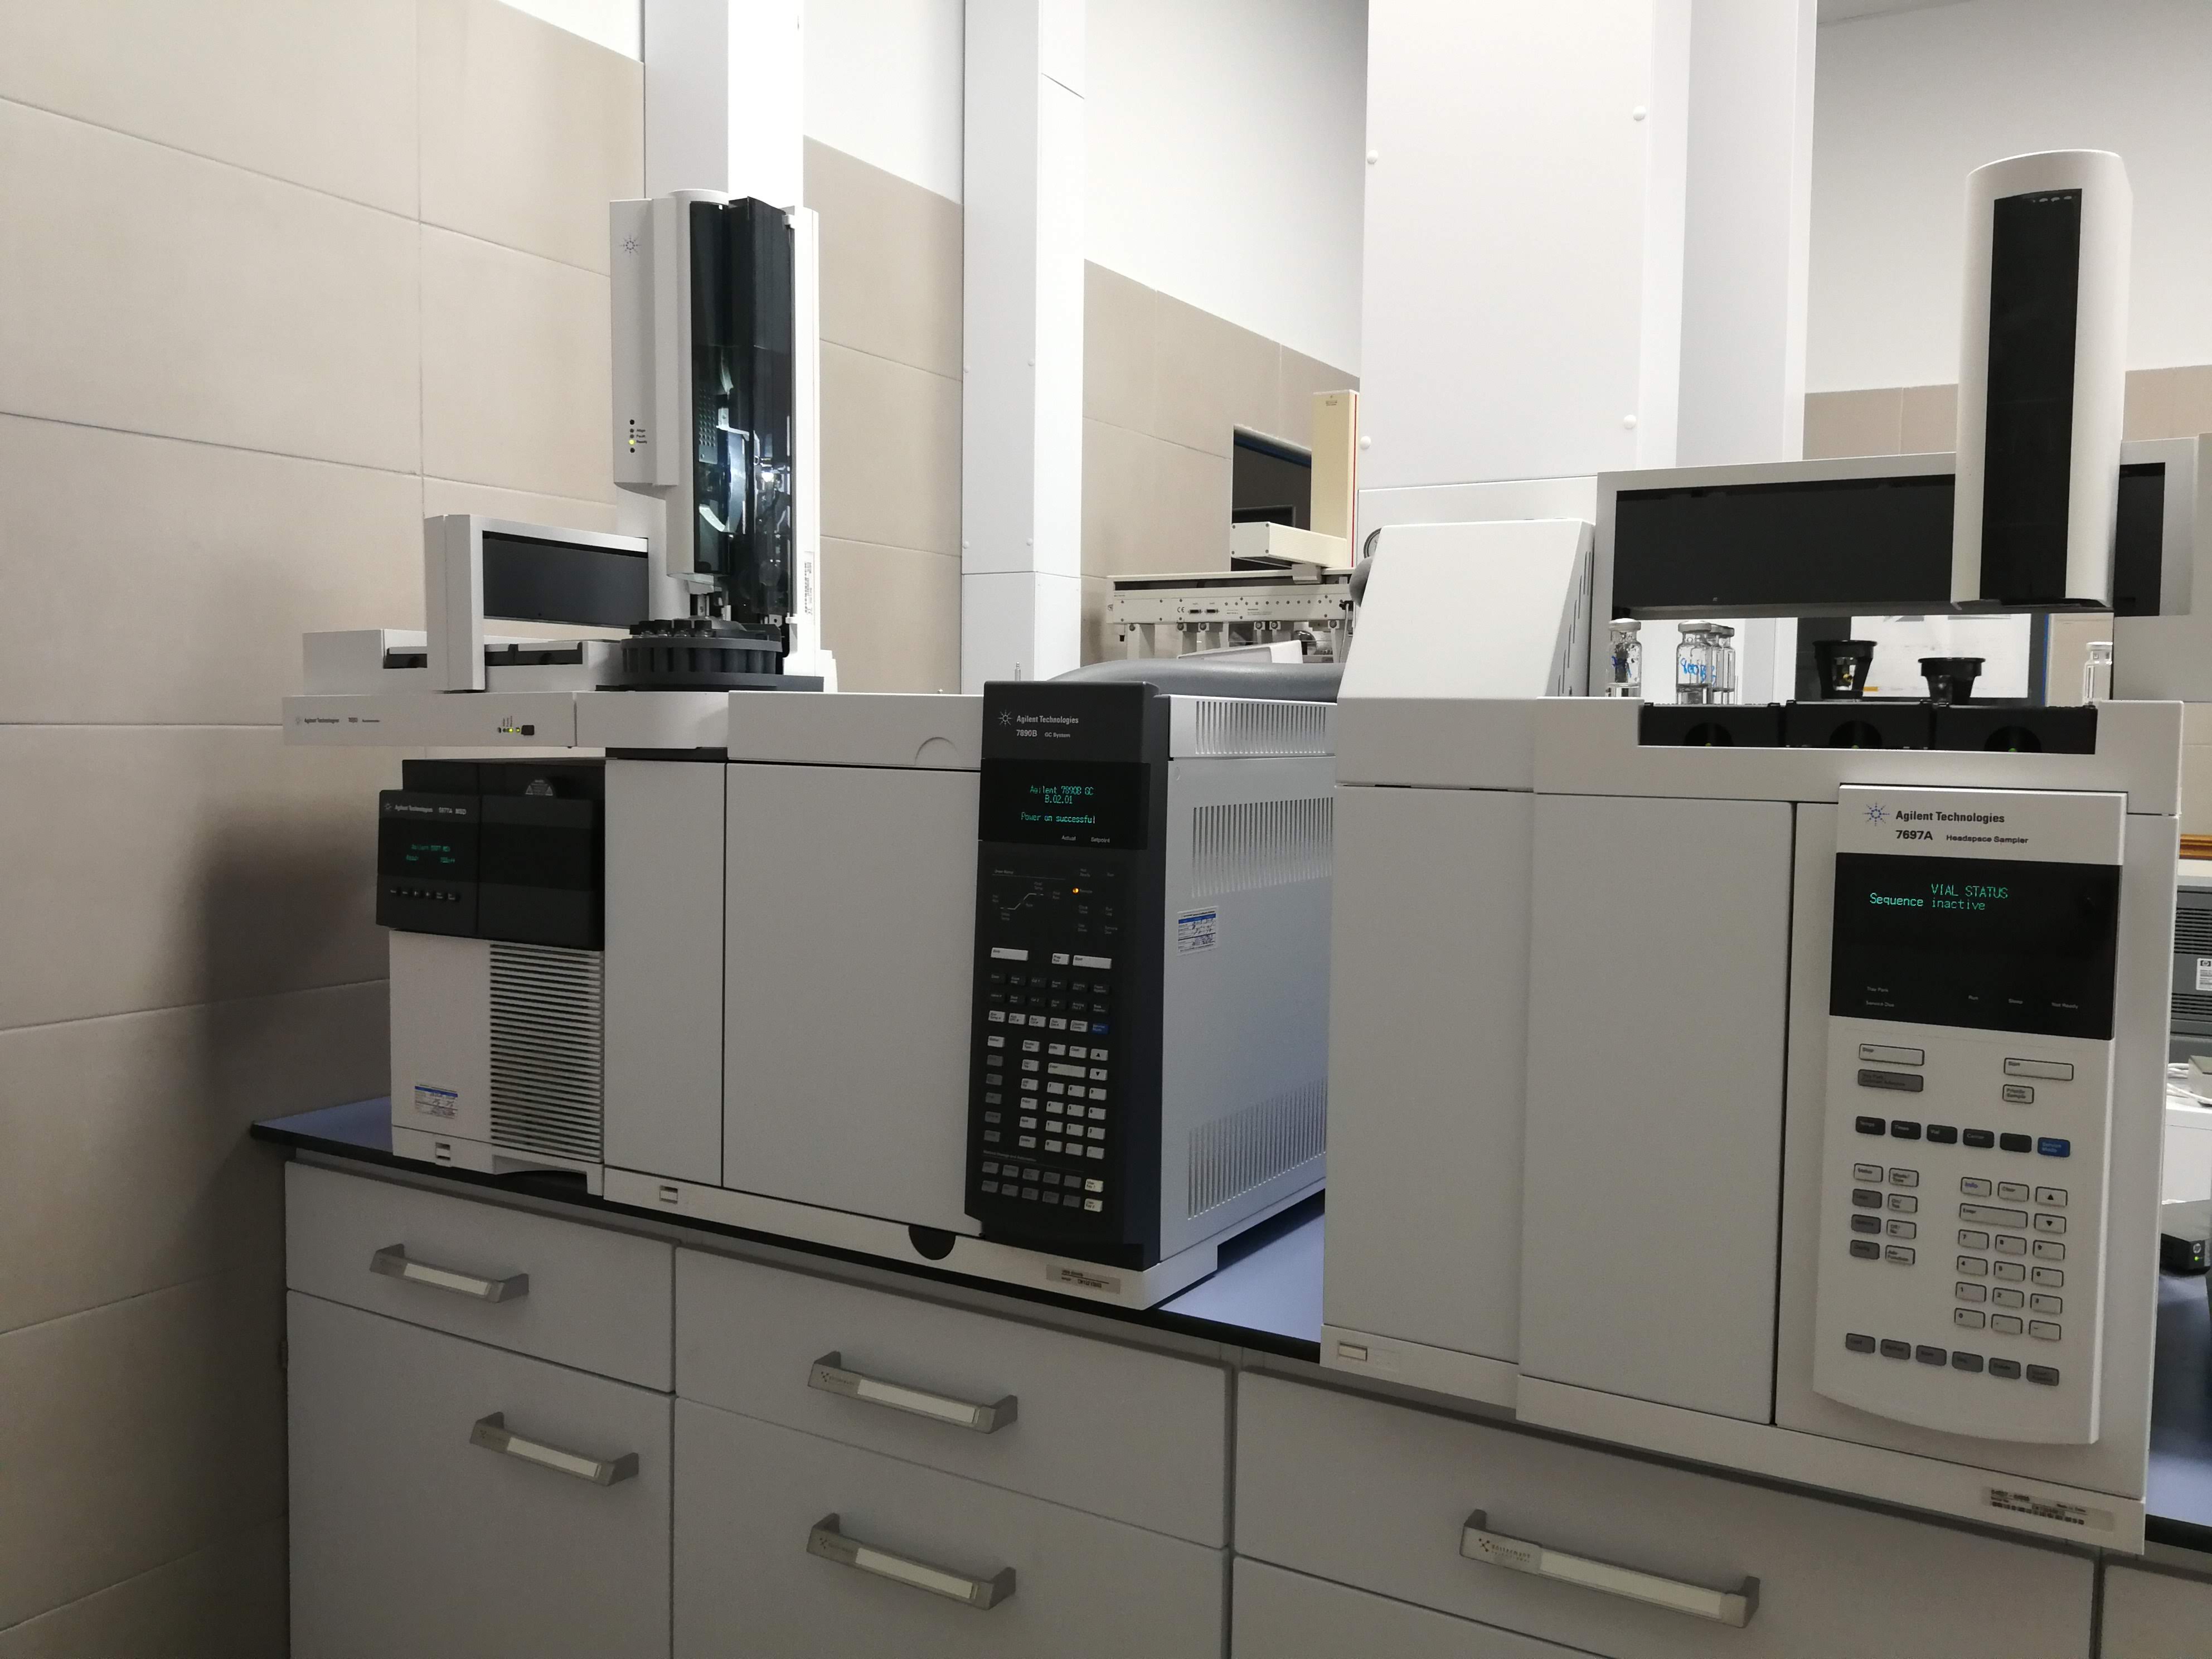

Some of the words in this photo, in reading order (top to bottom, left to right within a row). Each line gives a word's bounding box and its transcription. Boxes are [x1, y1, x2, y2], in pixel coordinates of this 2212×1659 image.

[1017, 715, 1038, 724] Agilent
[1039, 716, 1079, 725] Technologies
[1030, 785, 1057, 794] Agilent
[1061, 786, 1081, 795] 7890B
[1085, 787, 1094, 795] GC
[1045, 795, 1073, 804] B.02.01
[1021, 812, 1041, 821] Power
[1056, 815, 1095, 824] successful
[1896, 810, 1933, 823] Agilent
[1936, 812, 2005, 824] Technologies
[1895, 830, 1933, 841] 7697A
[1946, 834, 1992, 843] Headspace
[1993, 836, 2029, 845] Sampler
[1931, 884, 1958, 896] VIAL
[1965, 886, 2008, 899] STATUS
[1870, 893, 1923, 907] Sequence
[1932, 899, 1985, 910] inactive
